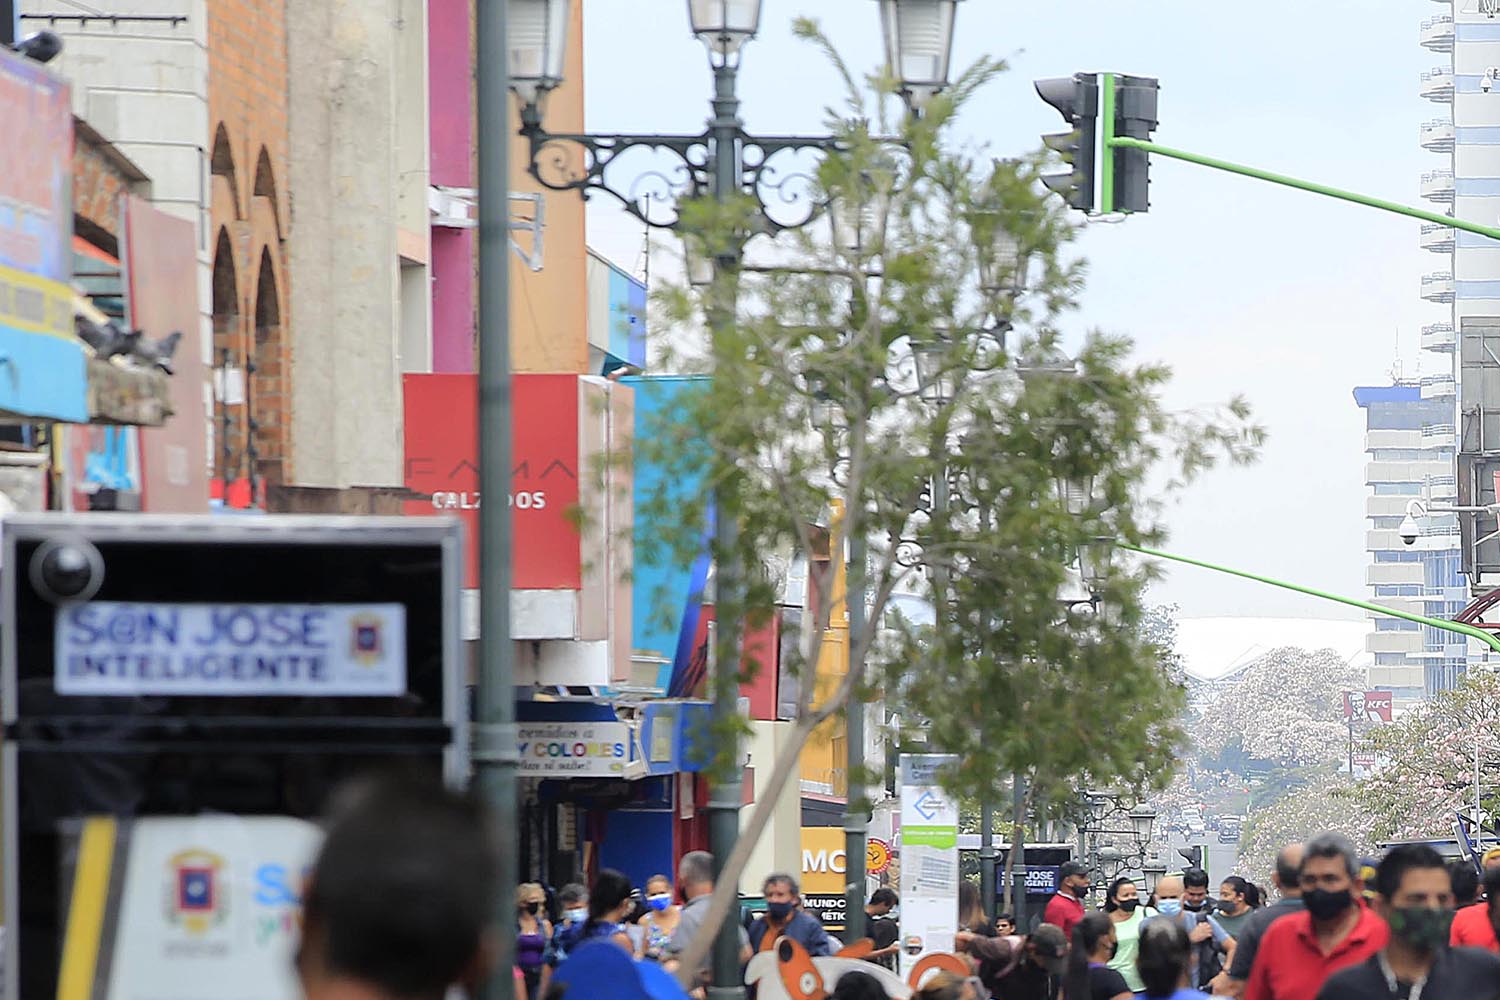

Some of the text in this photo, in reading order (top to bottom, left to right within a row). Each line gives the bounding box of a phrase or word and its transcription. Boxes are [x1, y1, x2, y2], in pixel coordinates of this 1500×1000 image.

[68, 655, 330, 680] INTELIGENTE
[1367, 700, 1390, 709] KFC
[534, 742, 624, 757] COLORES
[1025, 870, 1055, 880] JOSE
